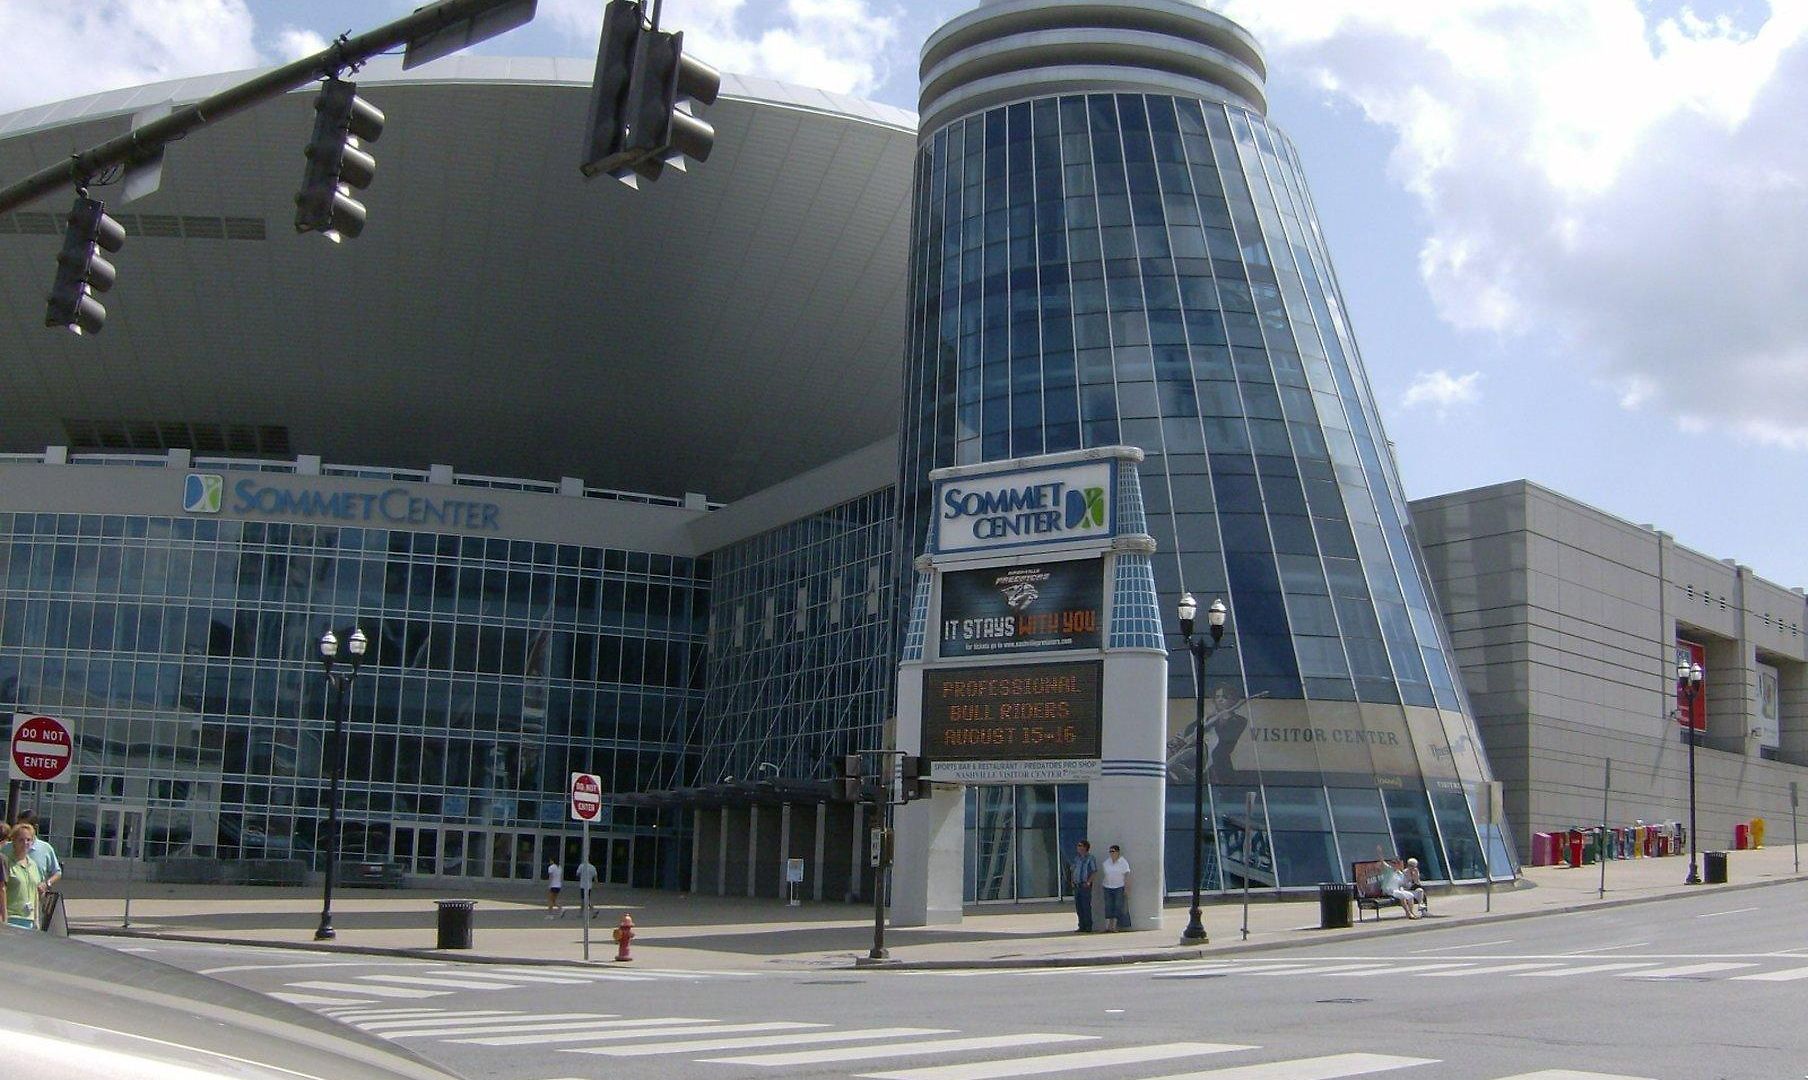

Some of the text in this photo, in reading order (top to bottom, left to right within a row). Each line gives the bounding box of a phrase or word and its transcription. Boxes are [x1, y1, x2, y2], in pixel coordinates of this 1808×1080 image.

[944, 481, 1064, 520] SOMMET
[973, 510, 1063, 540] CENTER
[944, 609, 1097, 641] IT STAYS WITH YOU
[943, 676, 1082, 698] PROFESSIONAL
[949, 701, 1071, 721] BULL RIDERS
[22, 728, 65, 741] DO NOT
[943, 725, 1077, 745] AUGUST 15-16
[1249, 727, 1399, 746] VISITOR CENTER
[23, 756, 58, 769] ENTER
